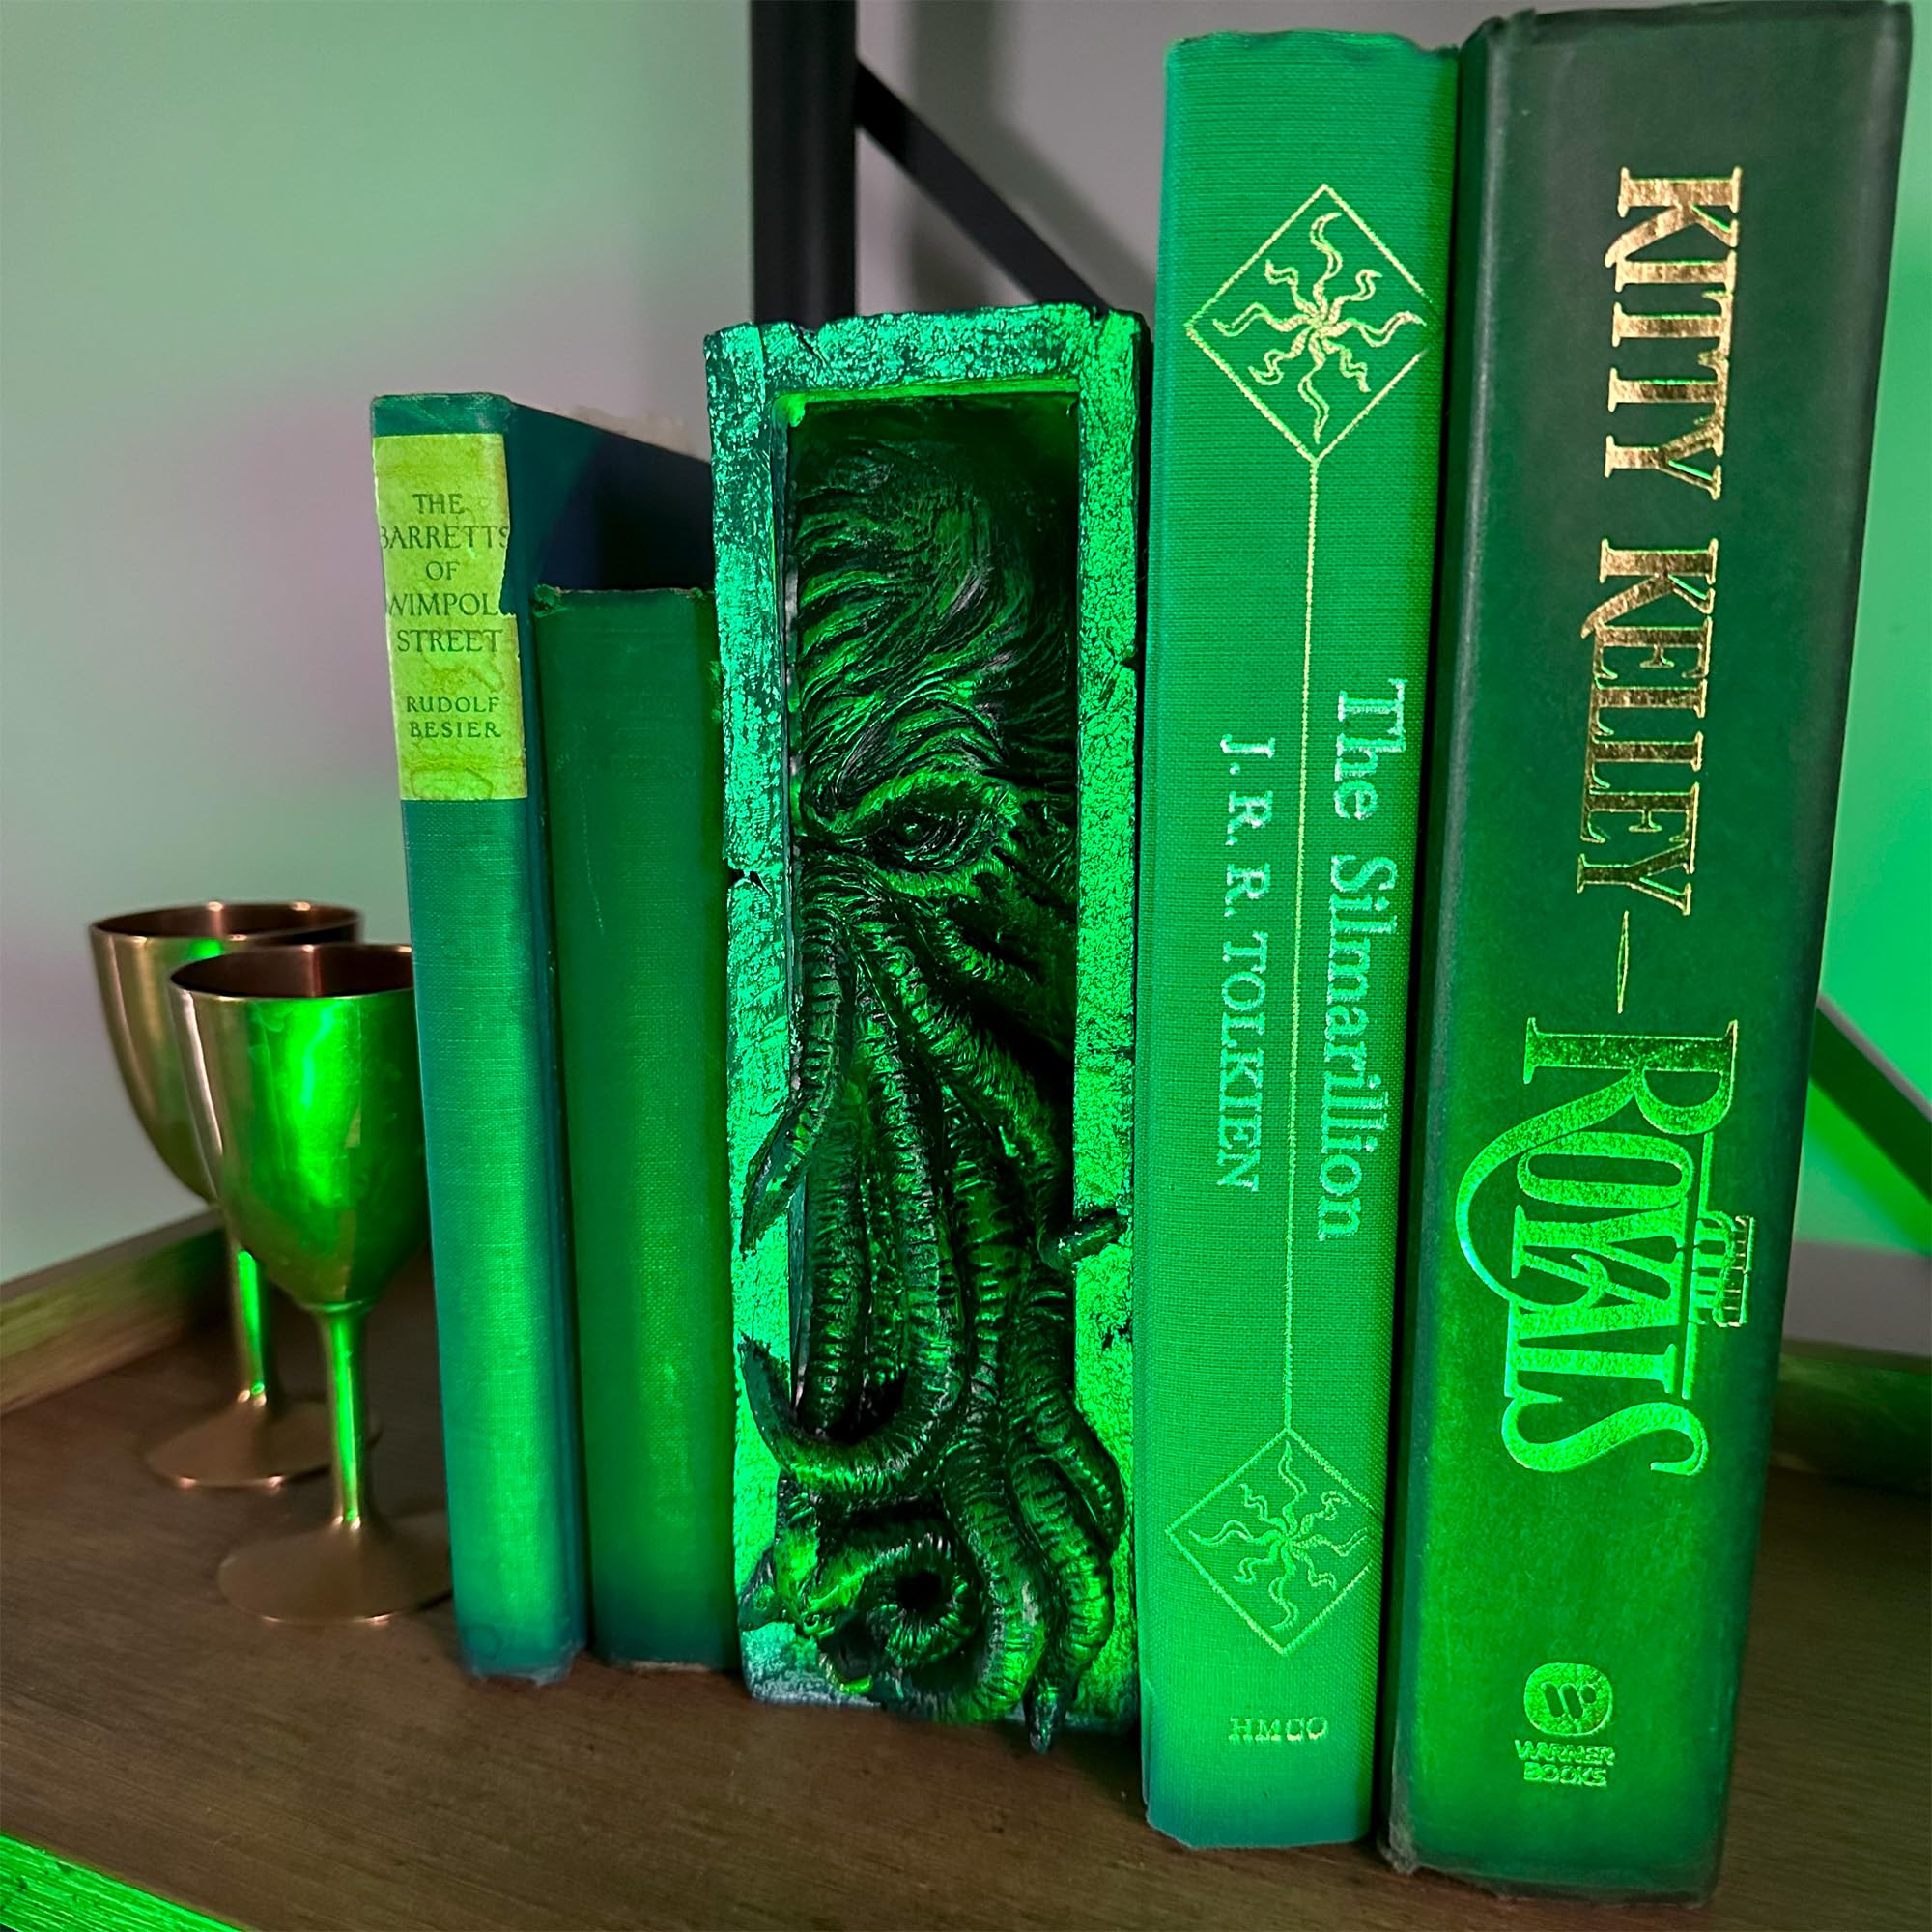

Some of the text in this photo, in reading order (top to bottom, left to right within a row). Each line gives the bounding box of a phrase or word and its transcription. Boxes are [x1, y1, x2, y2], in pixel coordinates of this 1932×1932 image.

[412, 493, 465, 514] THE
[1577, 165, 1743, 917] KITTY KELLEY
[425, 560, 462, 582] OF
[387, 593, 499, 616] WIMPOL
[397, 629, 503, 653] STREET
[407, 696, 500, 713] RUDOLF
[409, 722, 502, 738] BESIER
[1216, 733, 1276, 1192] J. R. R. TOLKIEN
[1318, 678, 1408, 1242] The Silmarillion
[1455, 1017, 1740, 1476] ROYALS
[1514, 1739, 1617, 1767] WARNER
[1523, 1761, 1609, 1788] BOOKS
